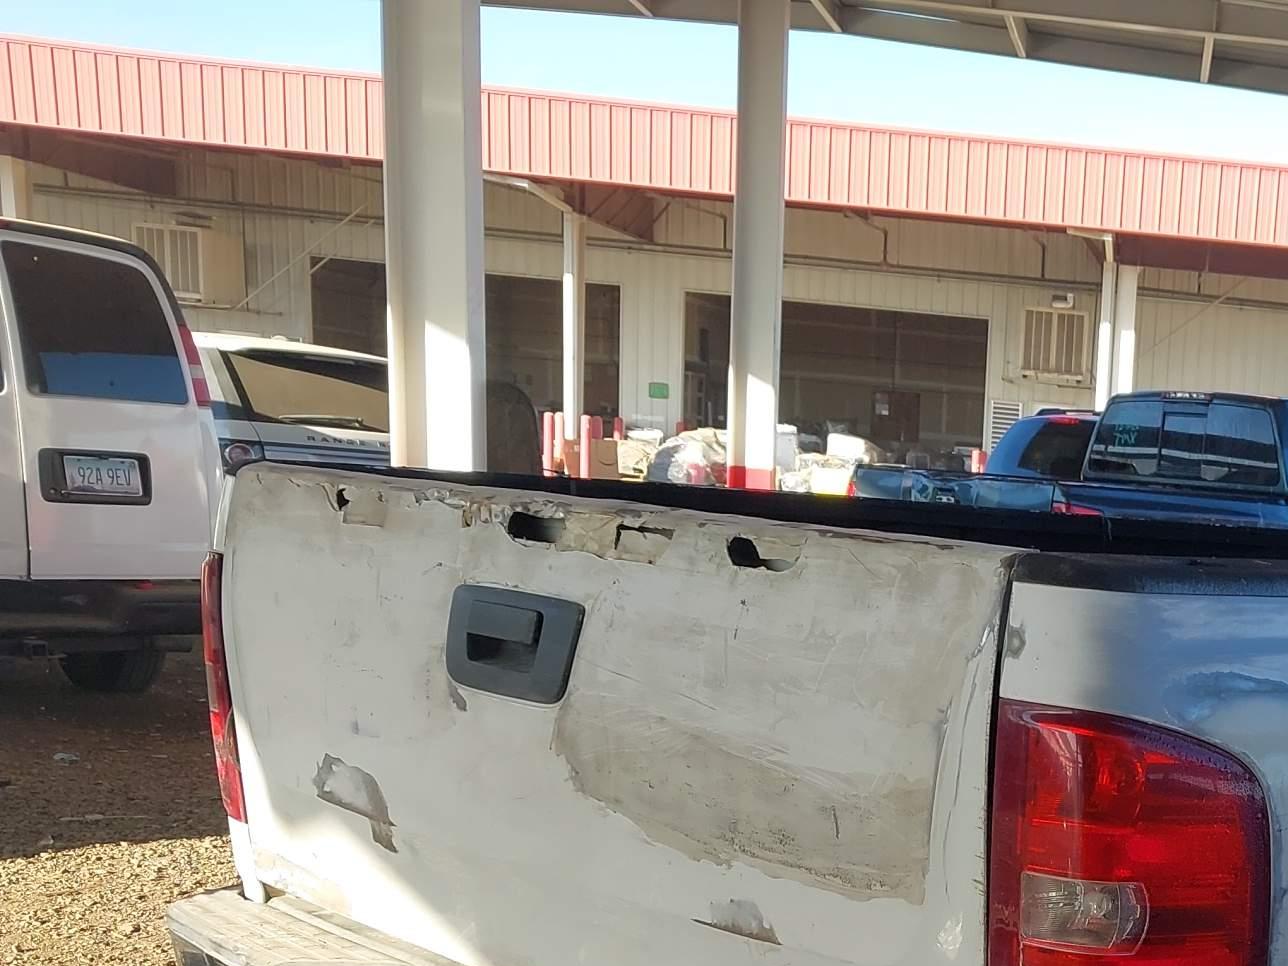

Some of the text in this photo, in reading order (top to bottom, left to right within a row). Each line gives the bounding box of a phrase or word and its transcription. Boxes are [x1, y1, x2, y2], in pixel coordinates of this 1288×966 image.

[306, 435, 366, 446] RANGE
[77, 466, 131, 486] 92A 9EV
